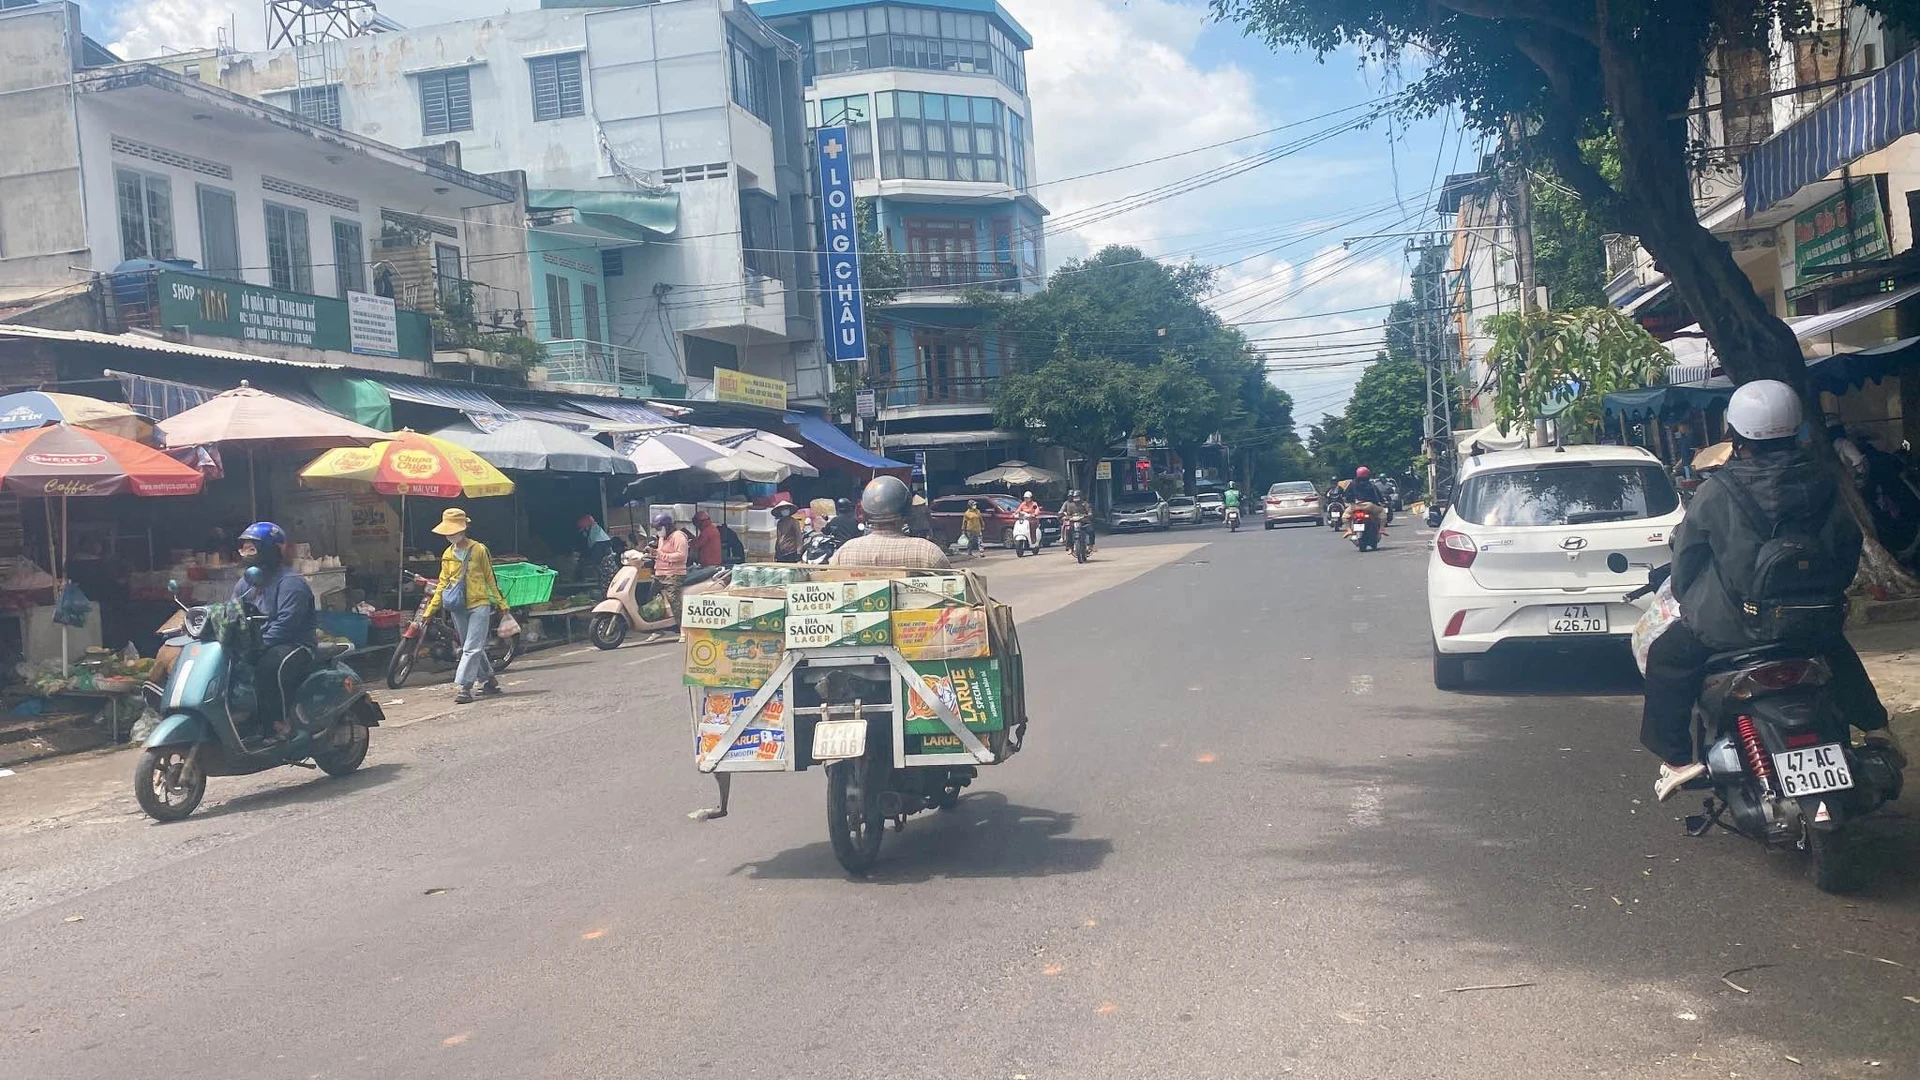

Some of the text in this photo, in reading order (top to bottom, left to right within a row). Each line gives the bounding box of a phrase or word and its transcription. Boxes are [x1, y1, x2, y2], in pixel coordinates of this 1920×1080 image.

[829, 168, 856, 346] LONG CHÂU
[172, 283, 195, 300] SHOP
[398, 454, 432, 464] Chupa
[44, 478, 94, 495] Coffee
[703, 599, 716, 607] BIA
[791, 592, 835, 603] SAIGON
[687, 605, 731, 617] SAIGON
[796, 603, 832, 611] LAGER
[1564, 606, 1589, 618] 47A
[691, 616, 727, 625] LAGER
[804, 617, 819, 625] BIA
[1554, 619, 1601, 631] 426.70
[790, 624, 834, 636] SAIGON
[794, 635, 831, 643] LAGER
[951, 668, 978, 723] LARUE
[971, 681, 985, 709] SPECIAL
[735, 733, 760, 746] ARUE
[923, 735, 960, 747] LARUE
[759, 741, 778, 754] 400
[1787, 747, 1836, 772] 47-AC
[1784, 767, 1849, 794] 630.06
